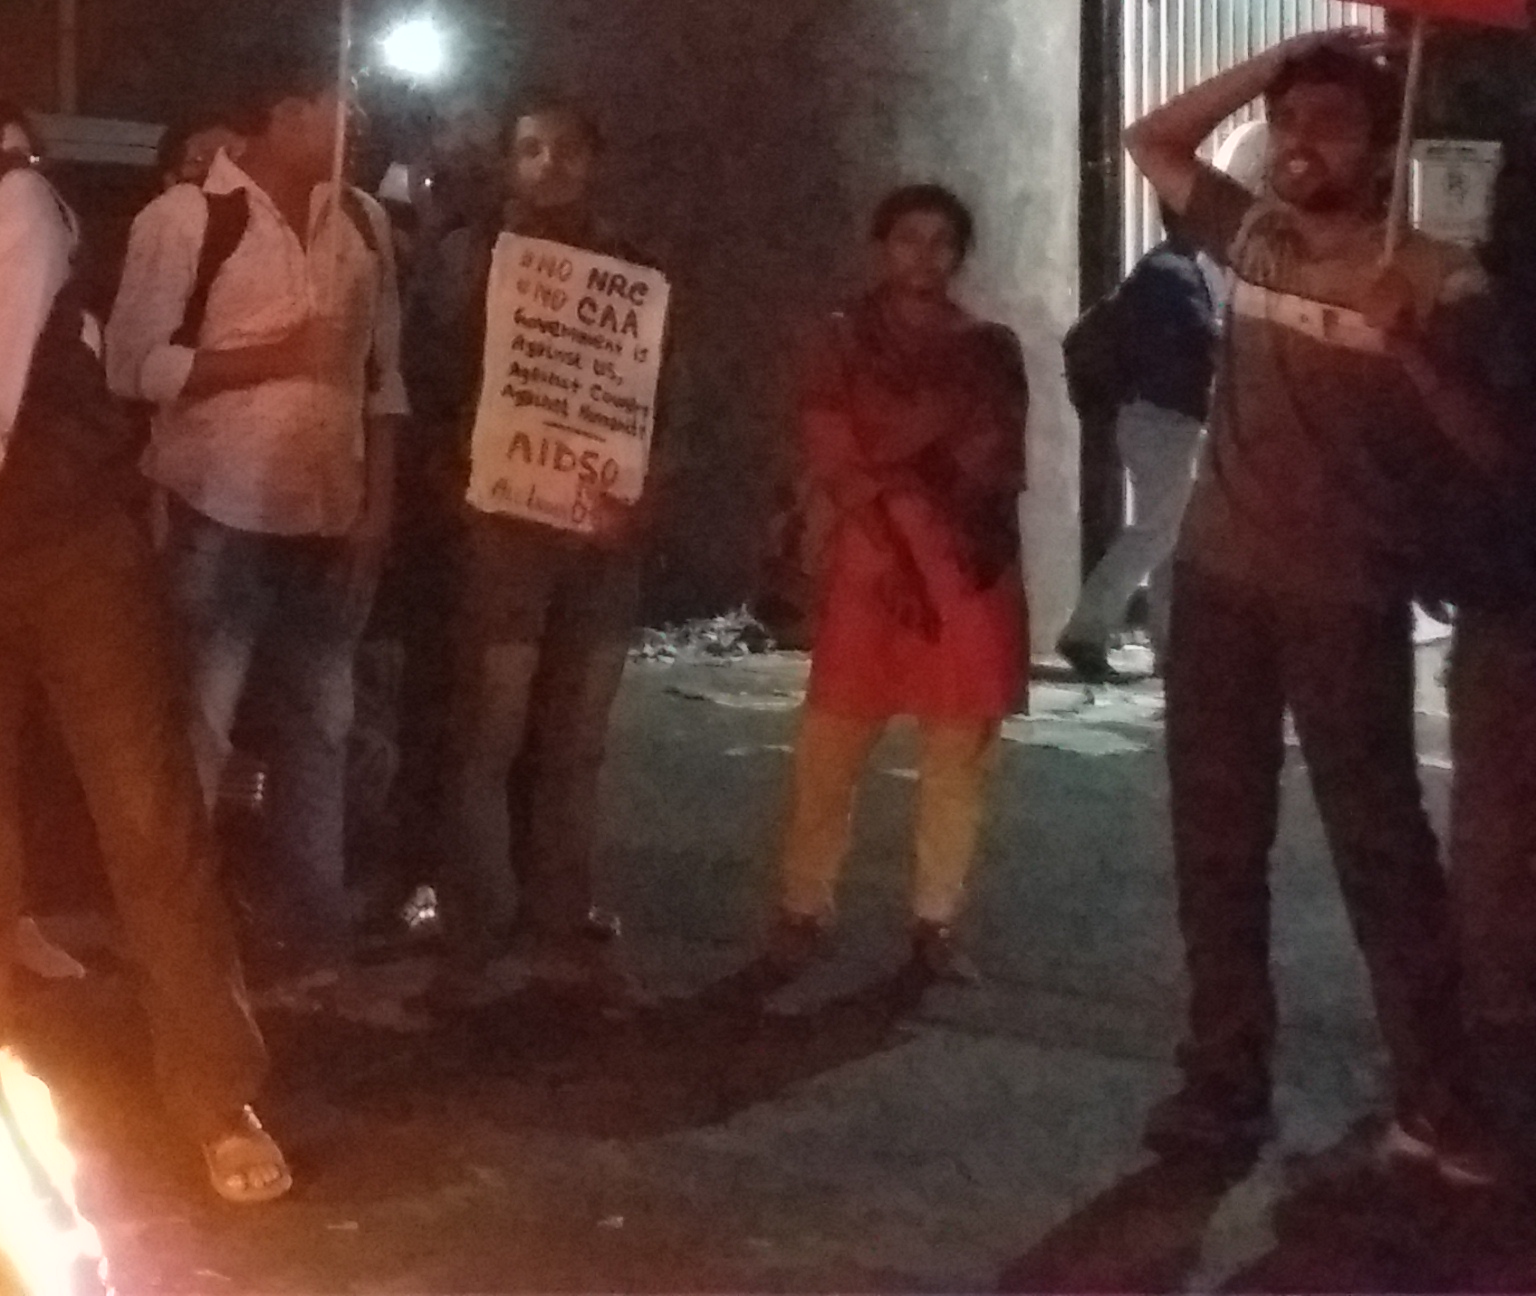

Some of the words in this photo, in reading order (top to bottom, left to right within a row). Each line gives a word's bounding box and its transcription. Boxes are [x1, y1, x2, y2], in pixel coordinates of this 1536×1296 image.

[586, 266, 650, 306] NRC
[577, 296, 639, 339] CAA
[506, 431, 620, 488] AIDSO
